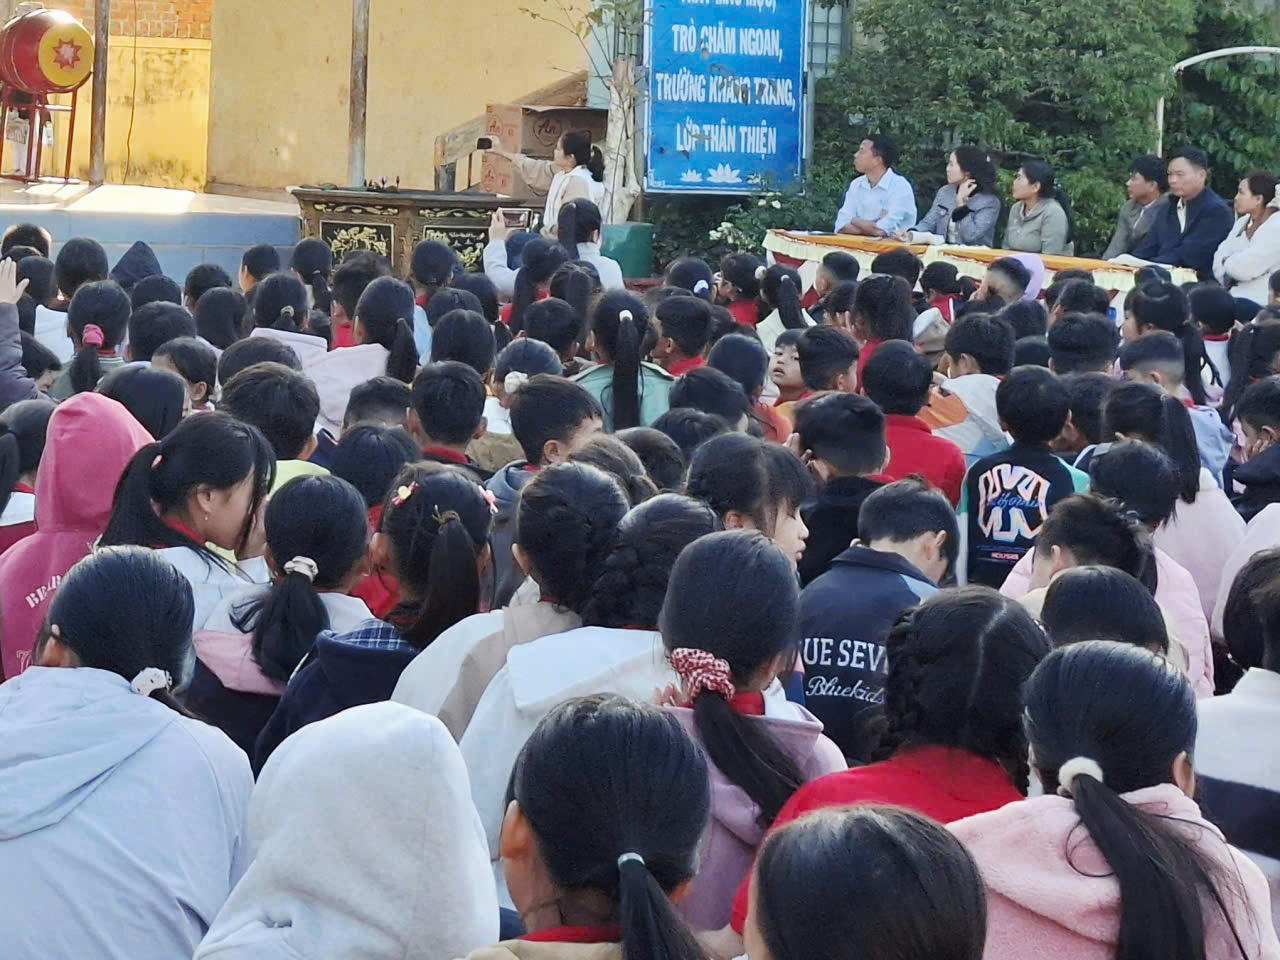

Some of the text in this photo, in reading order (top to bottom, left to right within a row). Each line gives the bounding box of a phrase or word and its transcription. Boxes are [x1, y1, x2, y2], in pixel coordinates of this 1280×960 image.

[672, 17, 697, 53] TRÒ
[739, 28, 783, 62] NGOAN,
[656, 66, 706, 103] TRƯỜNG
[676, 115, 777, 160] LỚP THÂN THIỆN
